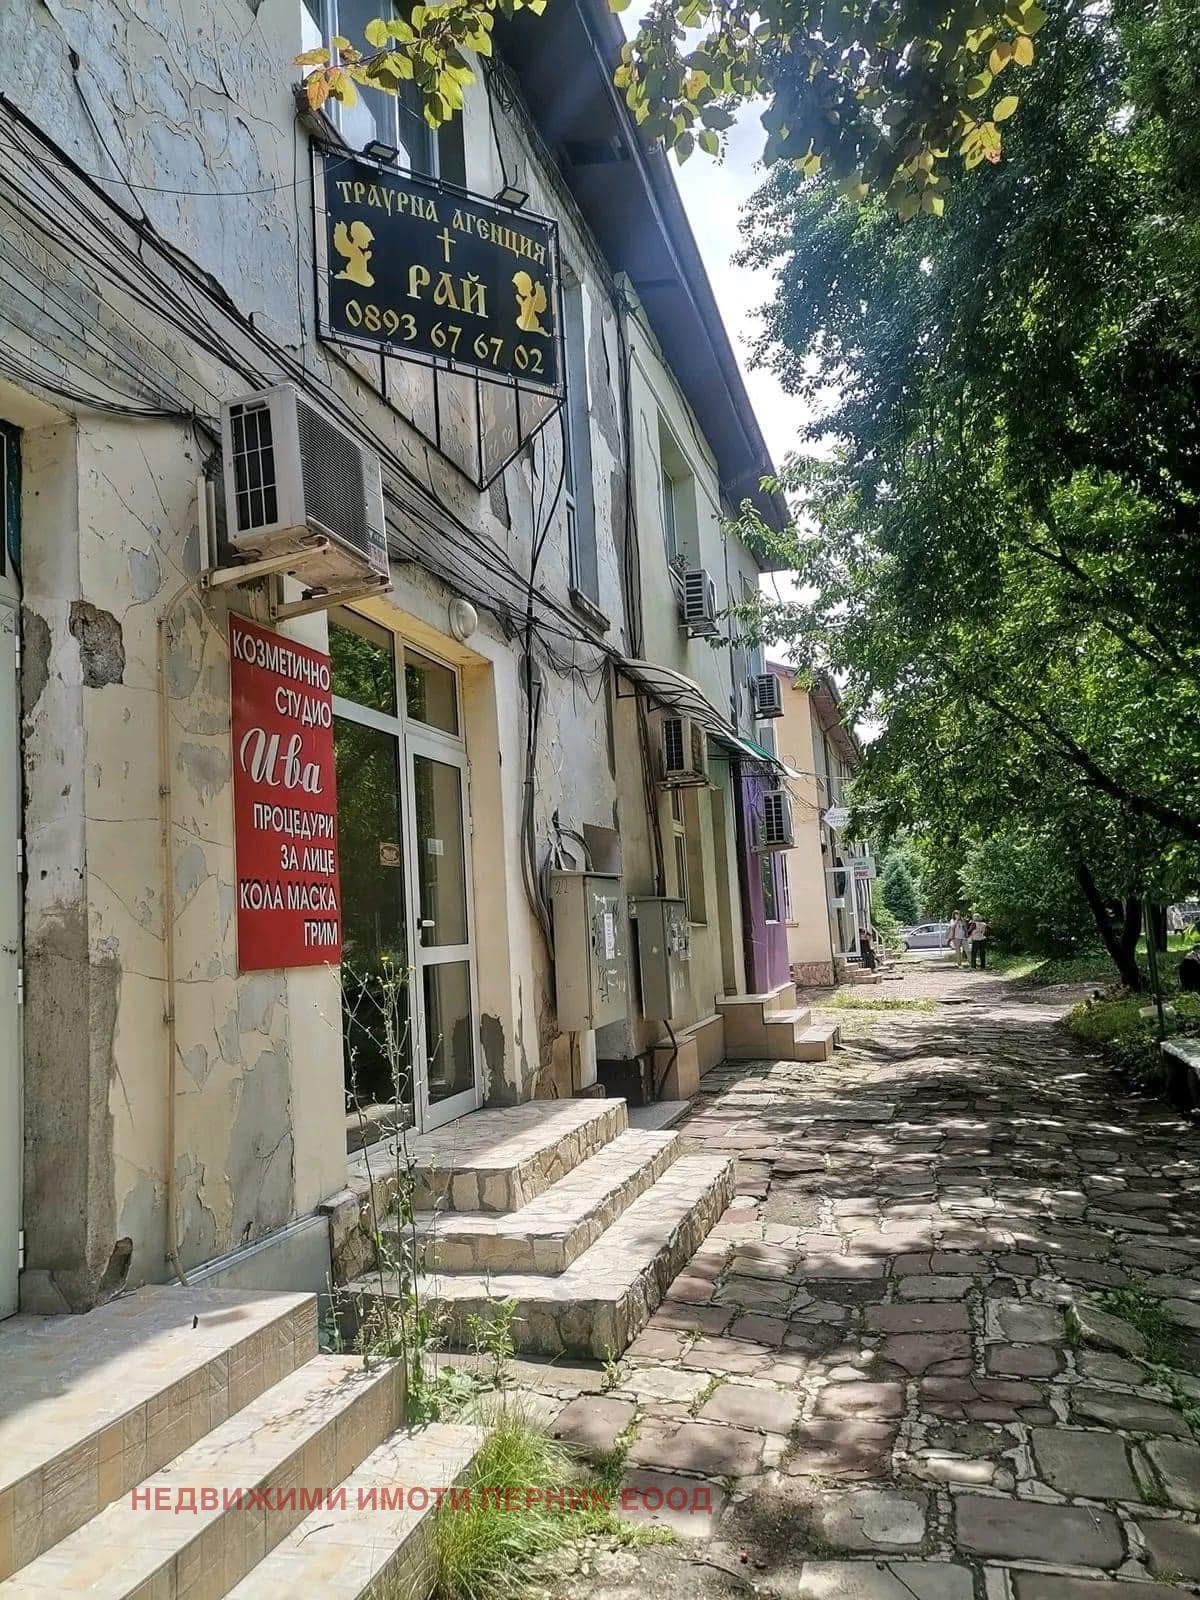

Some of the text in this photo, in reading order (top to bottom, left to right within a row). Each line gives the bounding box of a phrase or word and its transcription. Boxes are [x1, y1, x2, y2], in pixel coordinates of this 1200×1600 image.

[336, 181, 545, 265] ТРАУРНА АГЕНЦИЯ
[407, 264, 488, 318] РАЙ
[345, 299, 544, 374] 0893 67 67 02
[233, 629, 330, 691] КОЗМЕТИЧНО
[275, 686, 332, 729] СТУДИО
[240, 727, 323, 794] Ива
[253, 803, 334, 841] ПРОЦЕДУРИ
[280, 848, 335, 876] ЗА ЛИЦЕ
[240, 882, 337, 911] КОЛА МАСКА
[304, 921, 338, 946] ГРИМ
